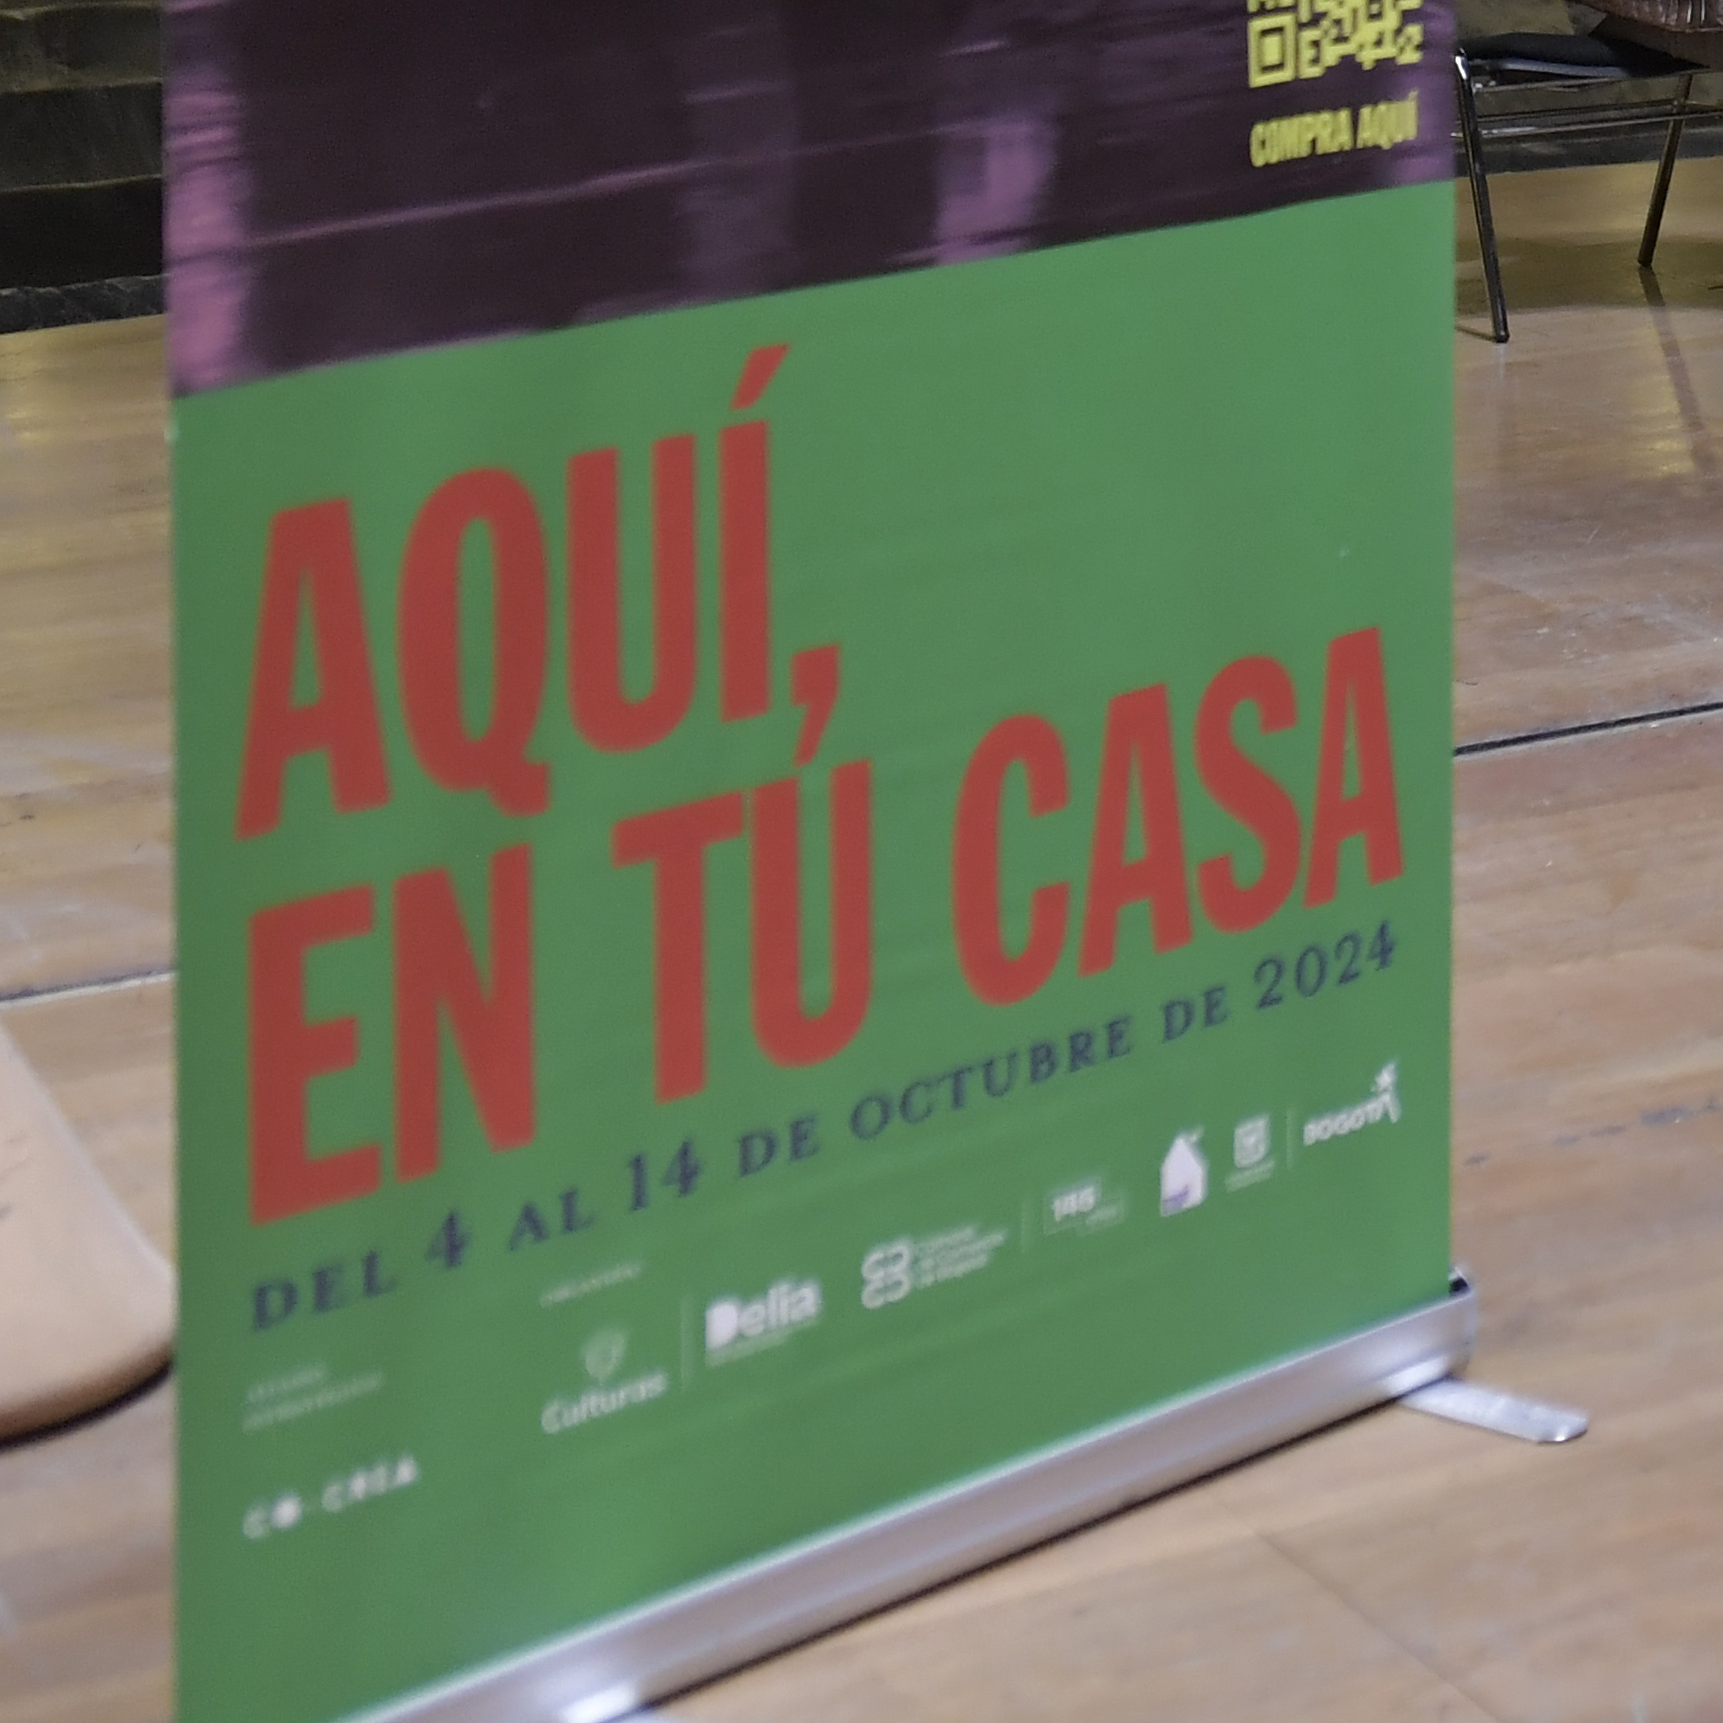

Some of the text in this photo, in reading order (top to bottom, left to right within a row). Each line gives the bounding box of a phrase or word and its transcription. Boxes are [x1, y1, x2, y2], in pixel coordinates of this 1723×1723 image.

[1356, 87, 1419, 150] AQUÍ
[234, 343, 842, 841] AQUÍ,
[248, 842, 538, 1226] EN
[950, 626, 1403, 1008] CASA
[251, 919, 1396, 1331] DEL 4 AL 14 DE OCTUBRE DE 2024
